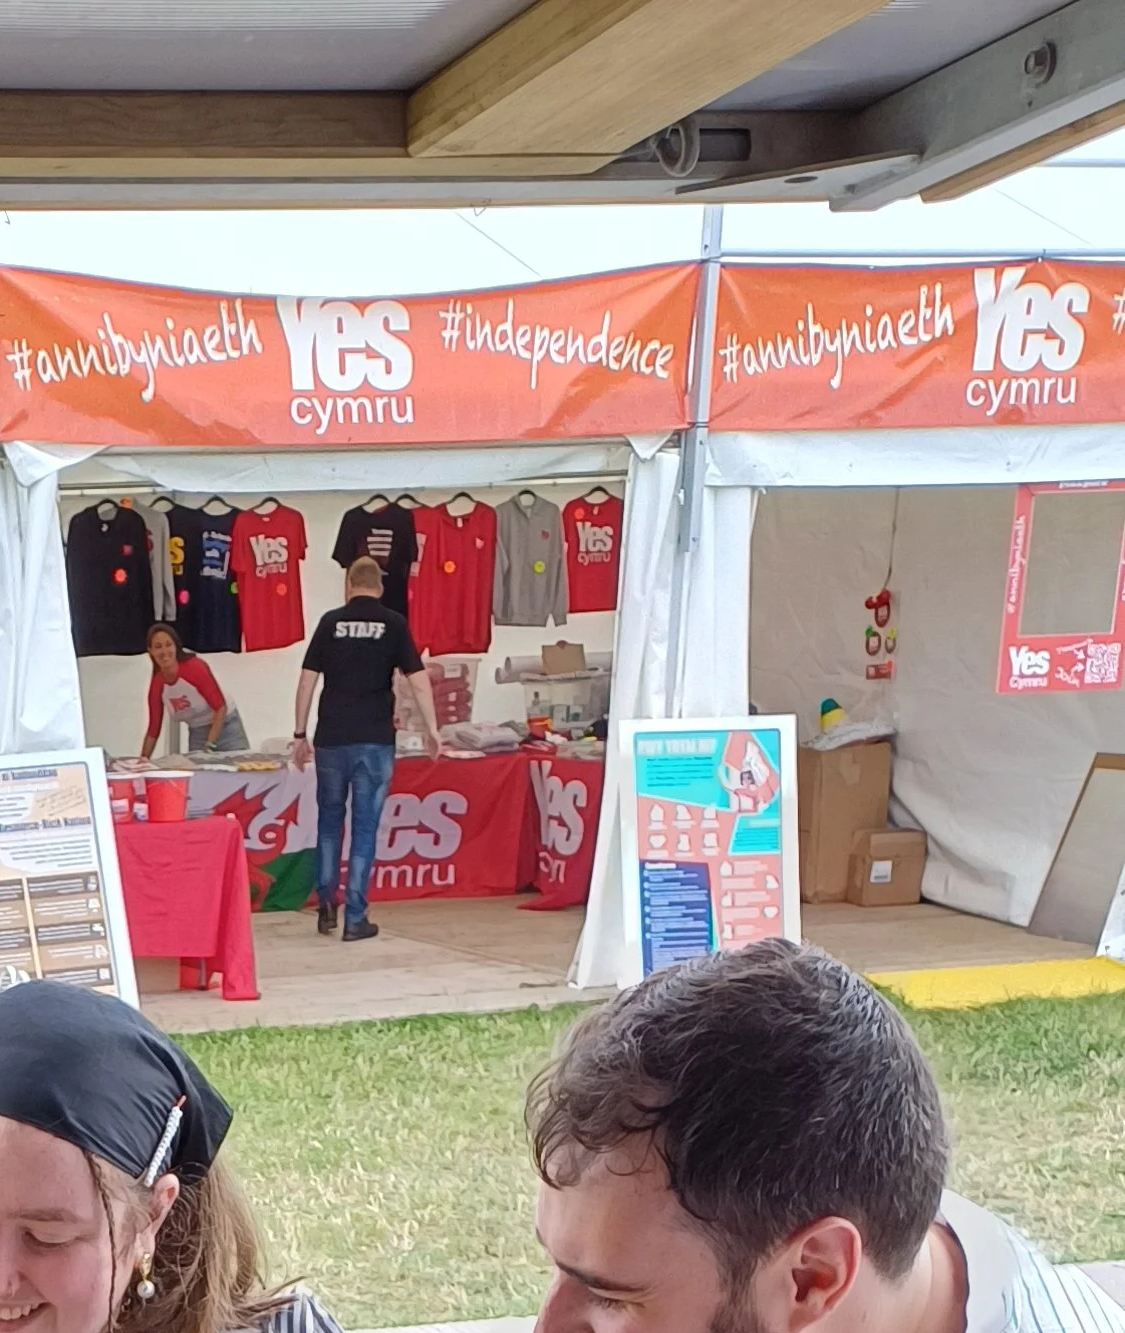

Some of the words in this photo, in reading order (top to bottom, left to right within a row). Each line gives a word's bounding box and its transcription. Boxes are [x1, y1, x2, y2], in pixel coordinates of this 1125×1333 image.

[275, 296, 414, 392] Yes
[438, 296, 676, 391] #independence
[718, 281, 955, 390] #annibyniaeth
[972, 266, 1090, 372] Yes
[5, 298, 264, 404] #annibyniaeth
[290, 393, 414, 435] cymru
[966, 376, 1077, 417] cymru
[249, 533, 289, 565] Yes
[576, 521, 615, 552] Yes
[334, 620, 386, 640] STAFF
[1008, 645, 1051, 675] Yes
[340, 789, 468, 861] es
